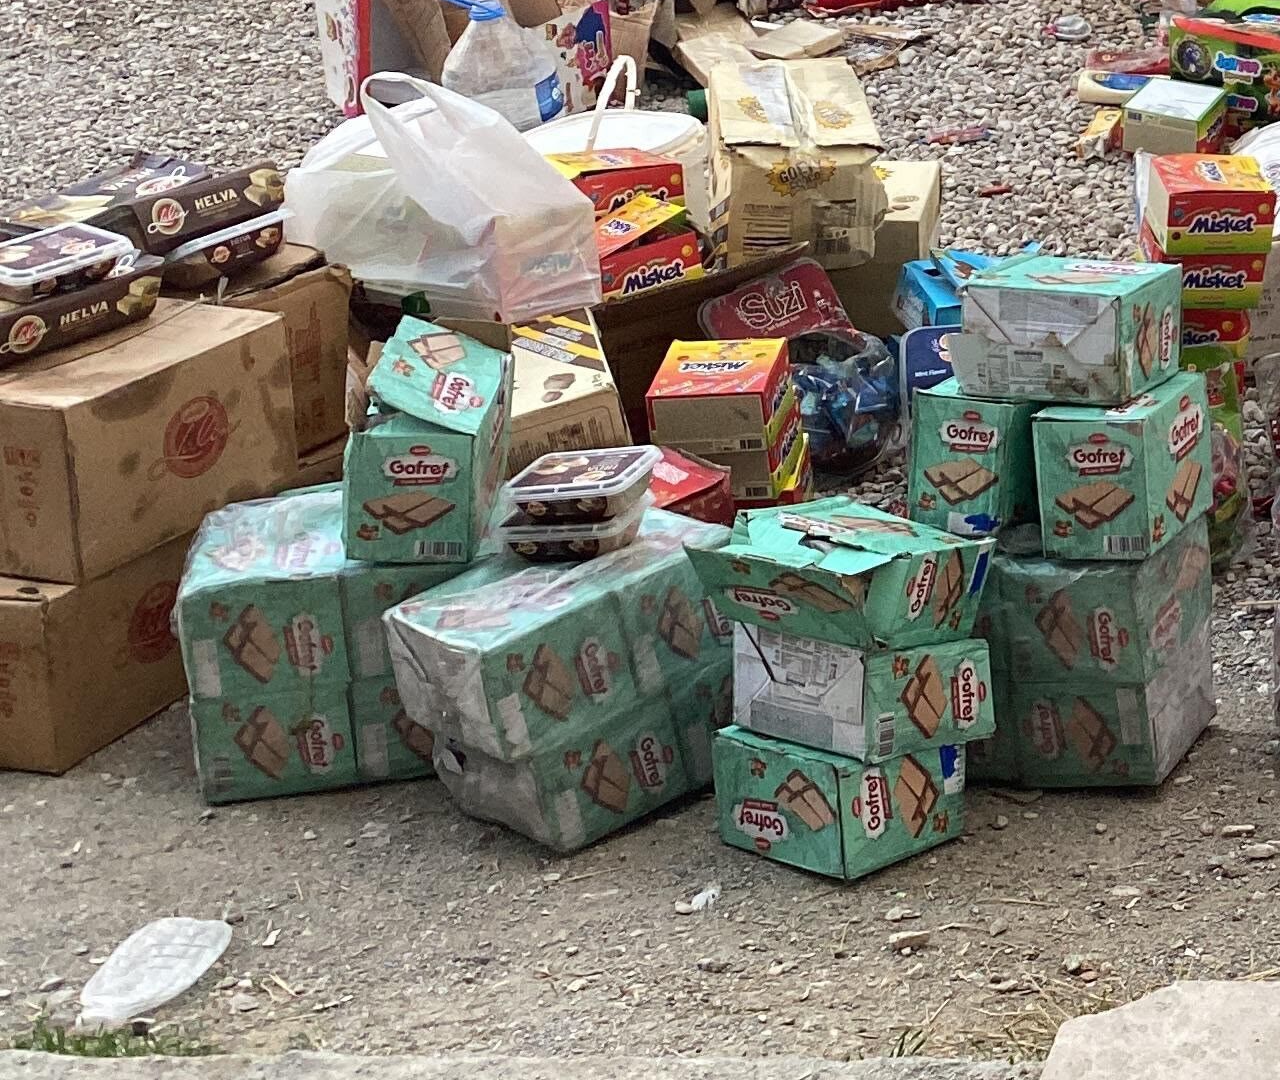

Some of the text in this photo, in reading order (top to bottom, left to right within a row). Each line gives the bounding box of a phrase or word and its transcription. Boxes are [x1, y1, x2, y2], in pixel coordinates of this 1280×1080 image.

[195, 187, 238, 211] HELVA
[610, 187, 668, 211] Miet
[1189, 212, 1255, 234] Misket
[623, 262, 686, 294] Misket
[1184, 269, 1245, 288] Misket
[60, 300, 109, 327] HELVA
[740, 281, 809, 330] Suzi
[679, 360, 747, 372] Misket
[946, 424, 995, 444] Gofret
[389, 459, 449, 477] Gofret
[1073, 447, 1126, 465] Gofret
[910, 558, 935, 613] Gofret
[961, 667, 974, 723] Gofret
[868, 774, 881, 830] Gofret
[740, 808, 784, 836] Gofret
